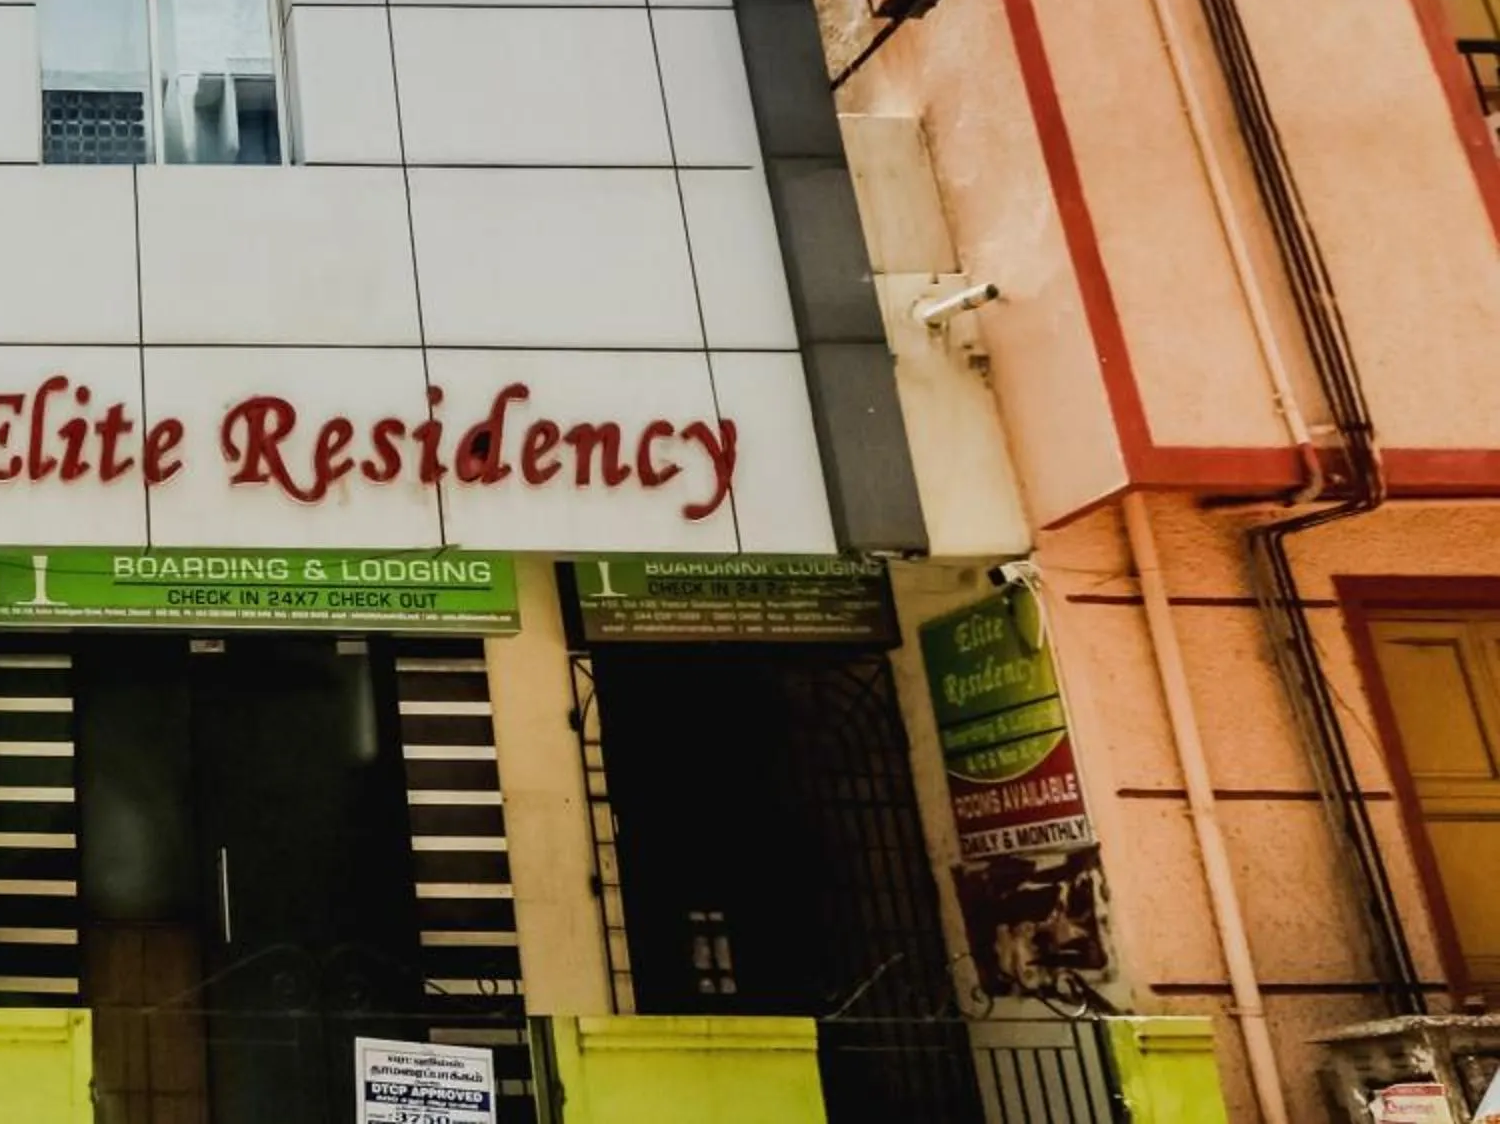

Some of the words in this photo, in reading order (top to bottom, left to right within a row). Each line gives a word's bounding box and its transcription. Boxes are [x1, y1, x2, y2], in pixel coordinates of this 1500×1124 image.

[220, 381, 739, 522] Residency
[113, 556, 289, 580] BOARDING
[303, 559, 328, 580] &
[341, 559, 492, 583] LODGING
[167, 589, 230, 606] CHECK
[239, 590, 259, 606] IN
[267, 591, 319, 607] 24X7
[328, 592, 392, 608] CHECK
[400, 593, 437, 609] OUT
[953, 614, 1005, 652] Elite
[943, 655, 1038, 707] Residency
[955, 788, 1001, 818] ROOMS
[1002, 772, 1078, 812] AVAILABLE
[961, 833, 999, 856] DAILY
[1015, 819, 1086, 848] MONTHLY
[371, 1083, 408, 1096] DTCP
[410, 1087, 483, 1103] APPROVED
